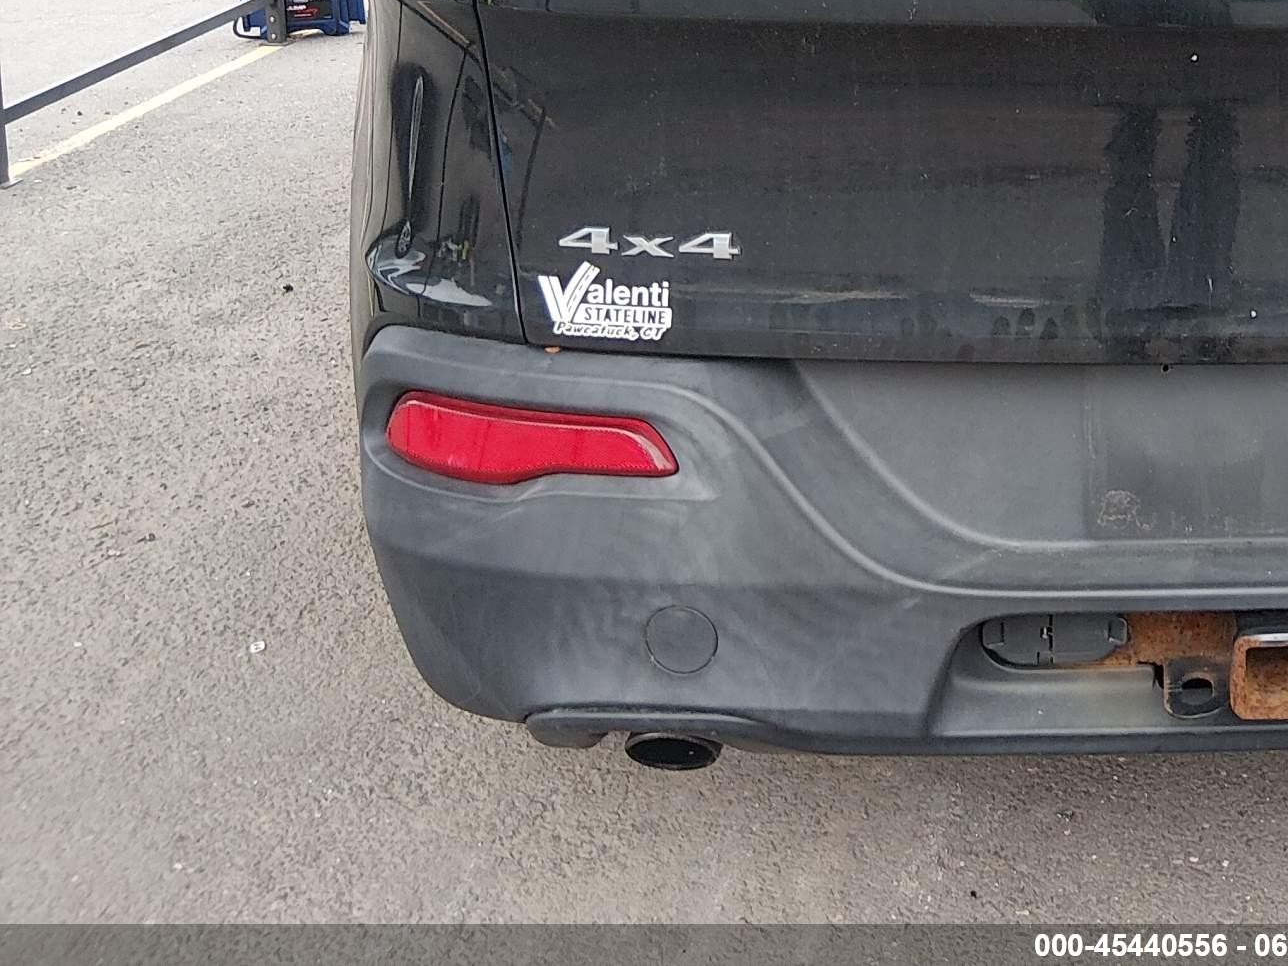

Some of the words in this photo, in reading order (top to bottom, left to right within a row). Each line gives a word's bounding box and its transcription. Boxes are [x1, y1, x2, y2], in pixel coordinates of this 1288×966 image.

[558, 226, 742, 260] 4x4
[537, 260, 670, 323] Valenti
[584, 307, 667, 325] STATELINE
